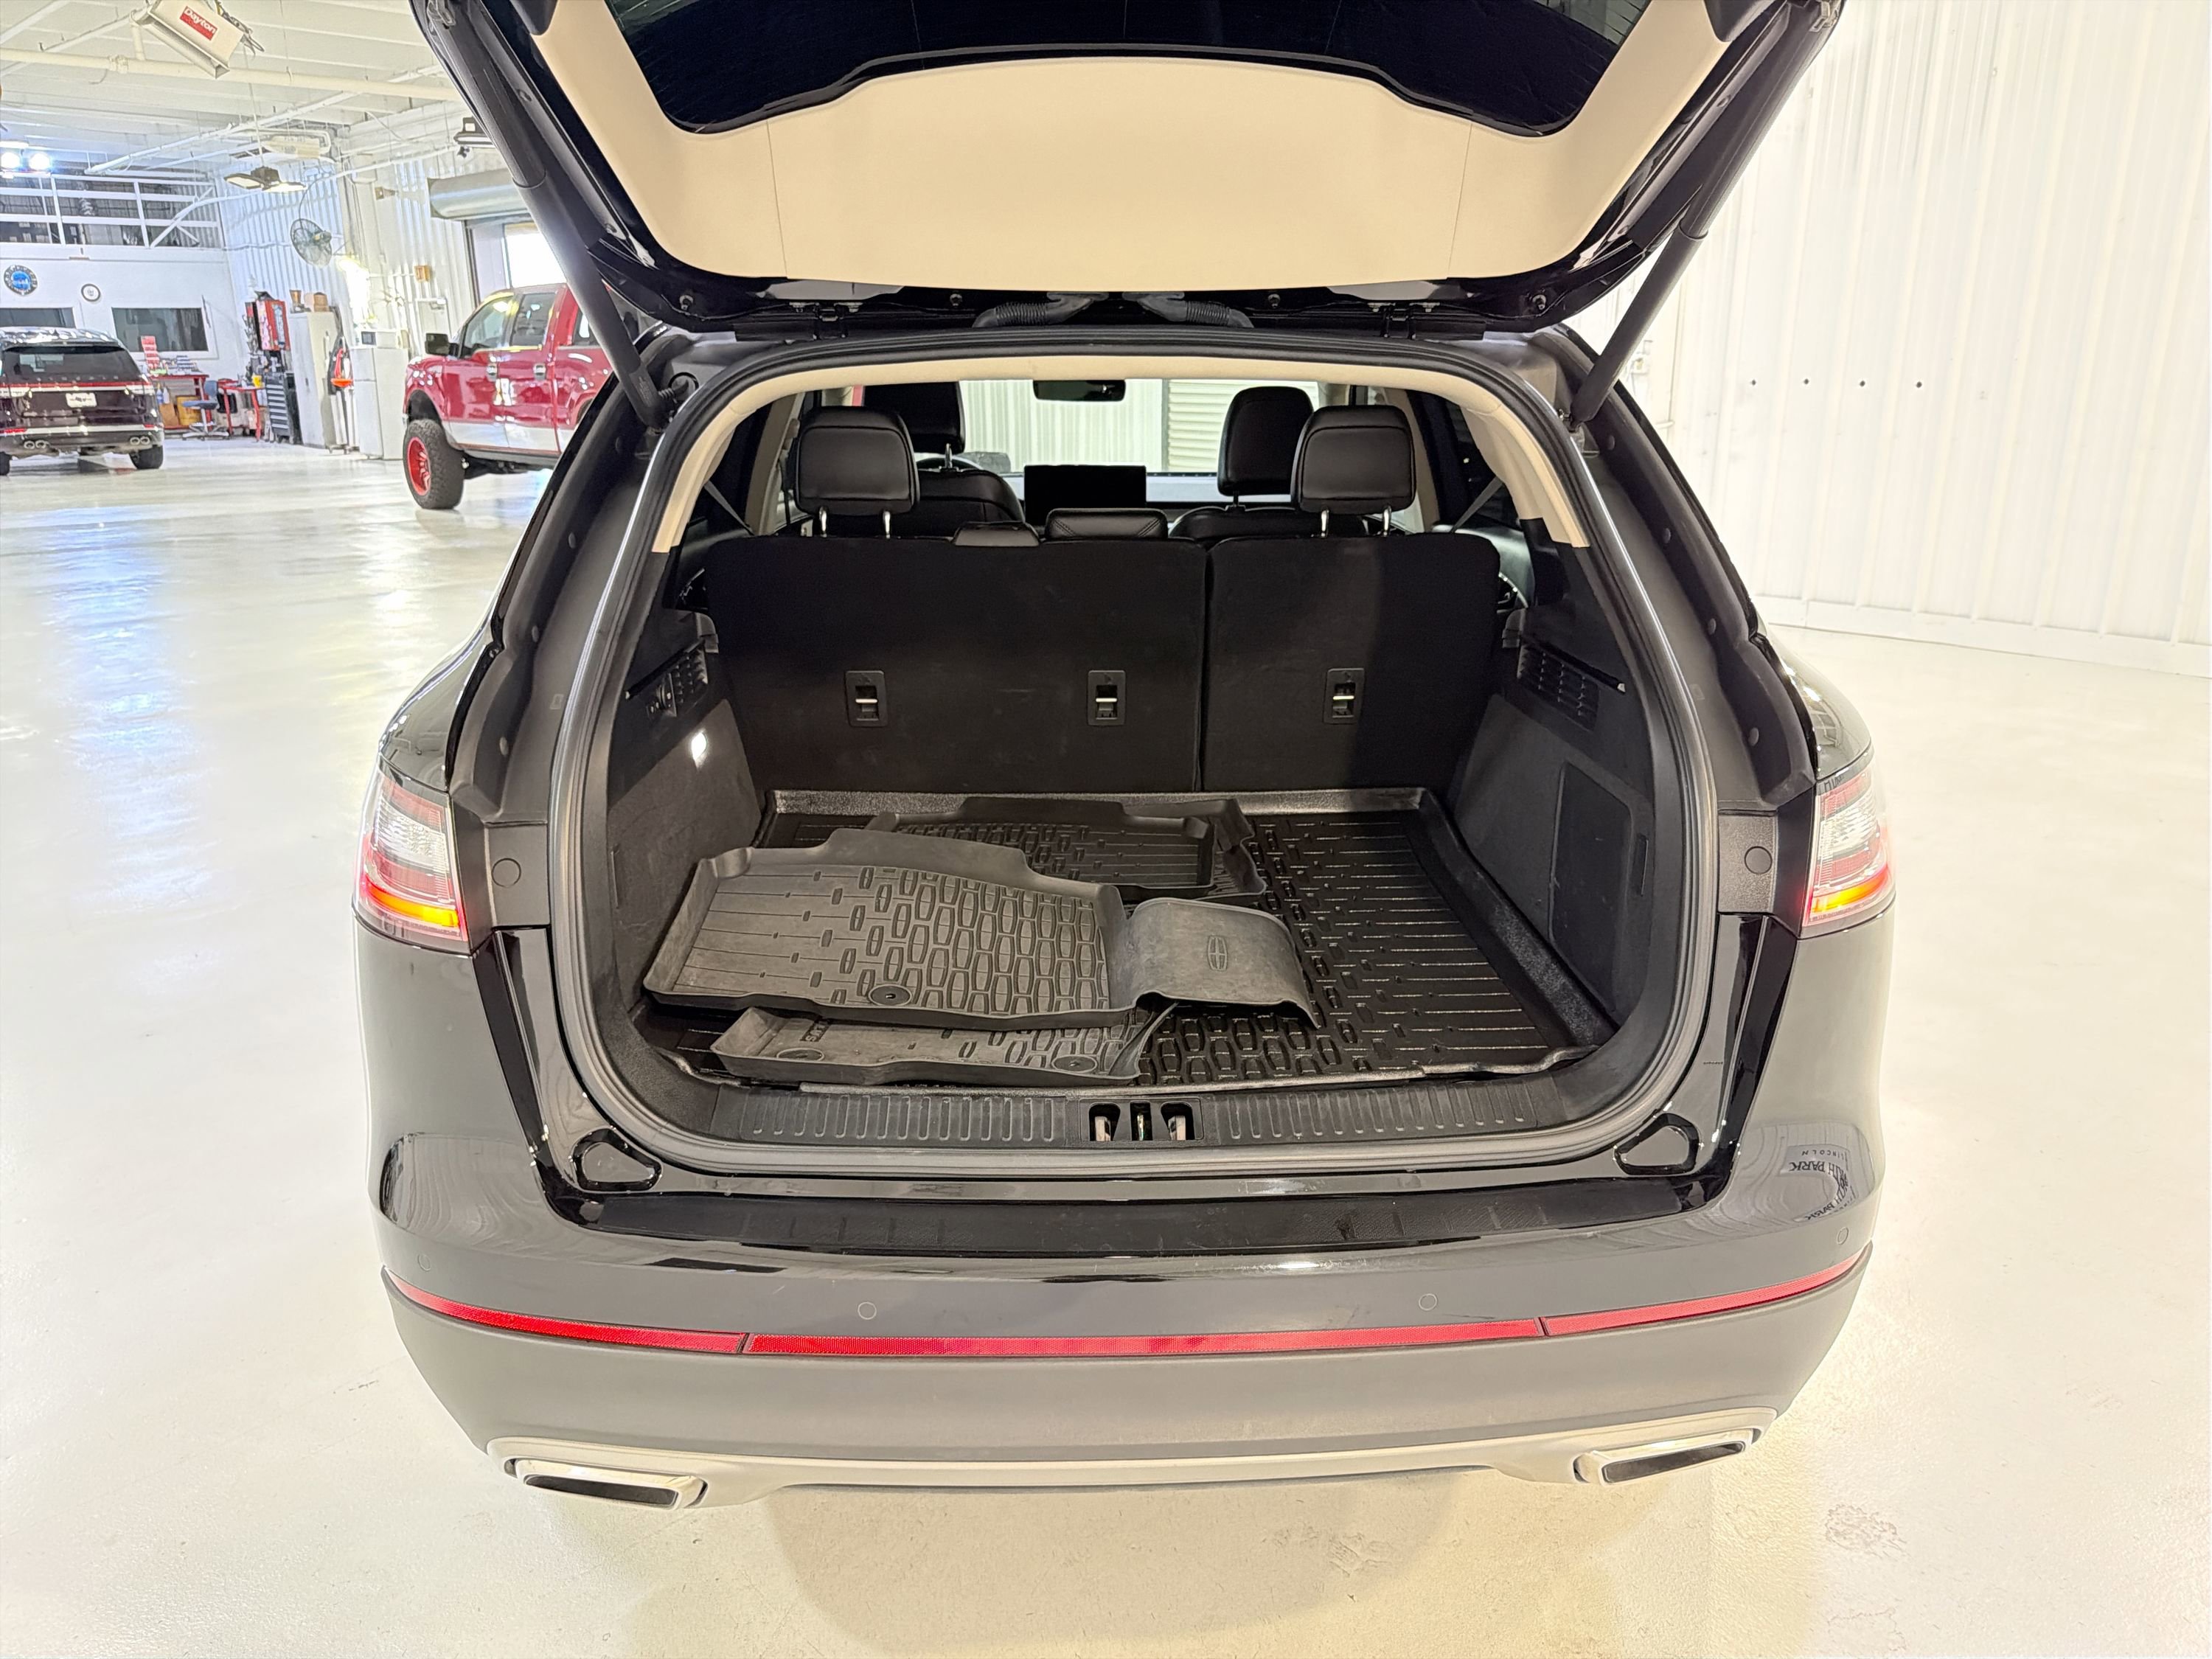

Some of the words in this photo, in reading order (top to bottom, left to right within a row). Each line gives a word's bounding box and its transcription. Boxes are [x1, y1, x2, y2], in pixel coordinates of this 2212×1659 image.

[184, 8, 216, 33] Dayton
[1801, 1150, 1844, 1161] LINCOLN
[1789, 1161, 1826, 1173] PARK
